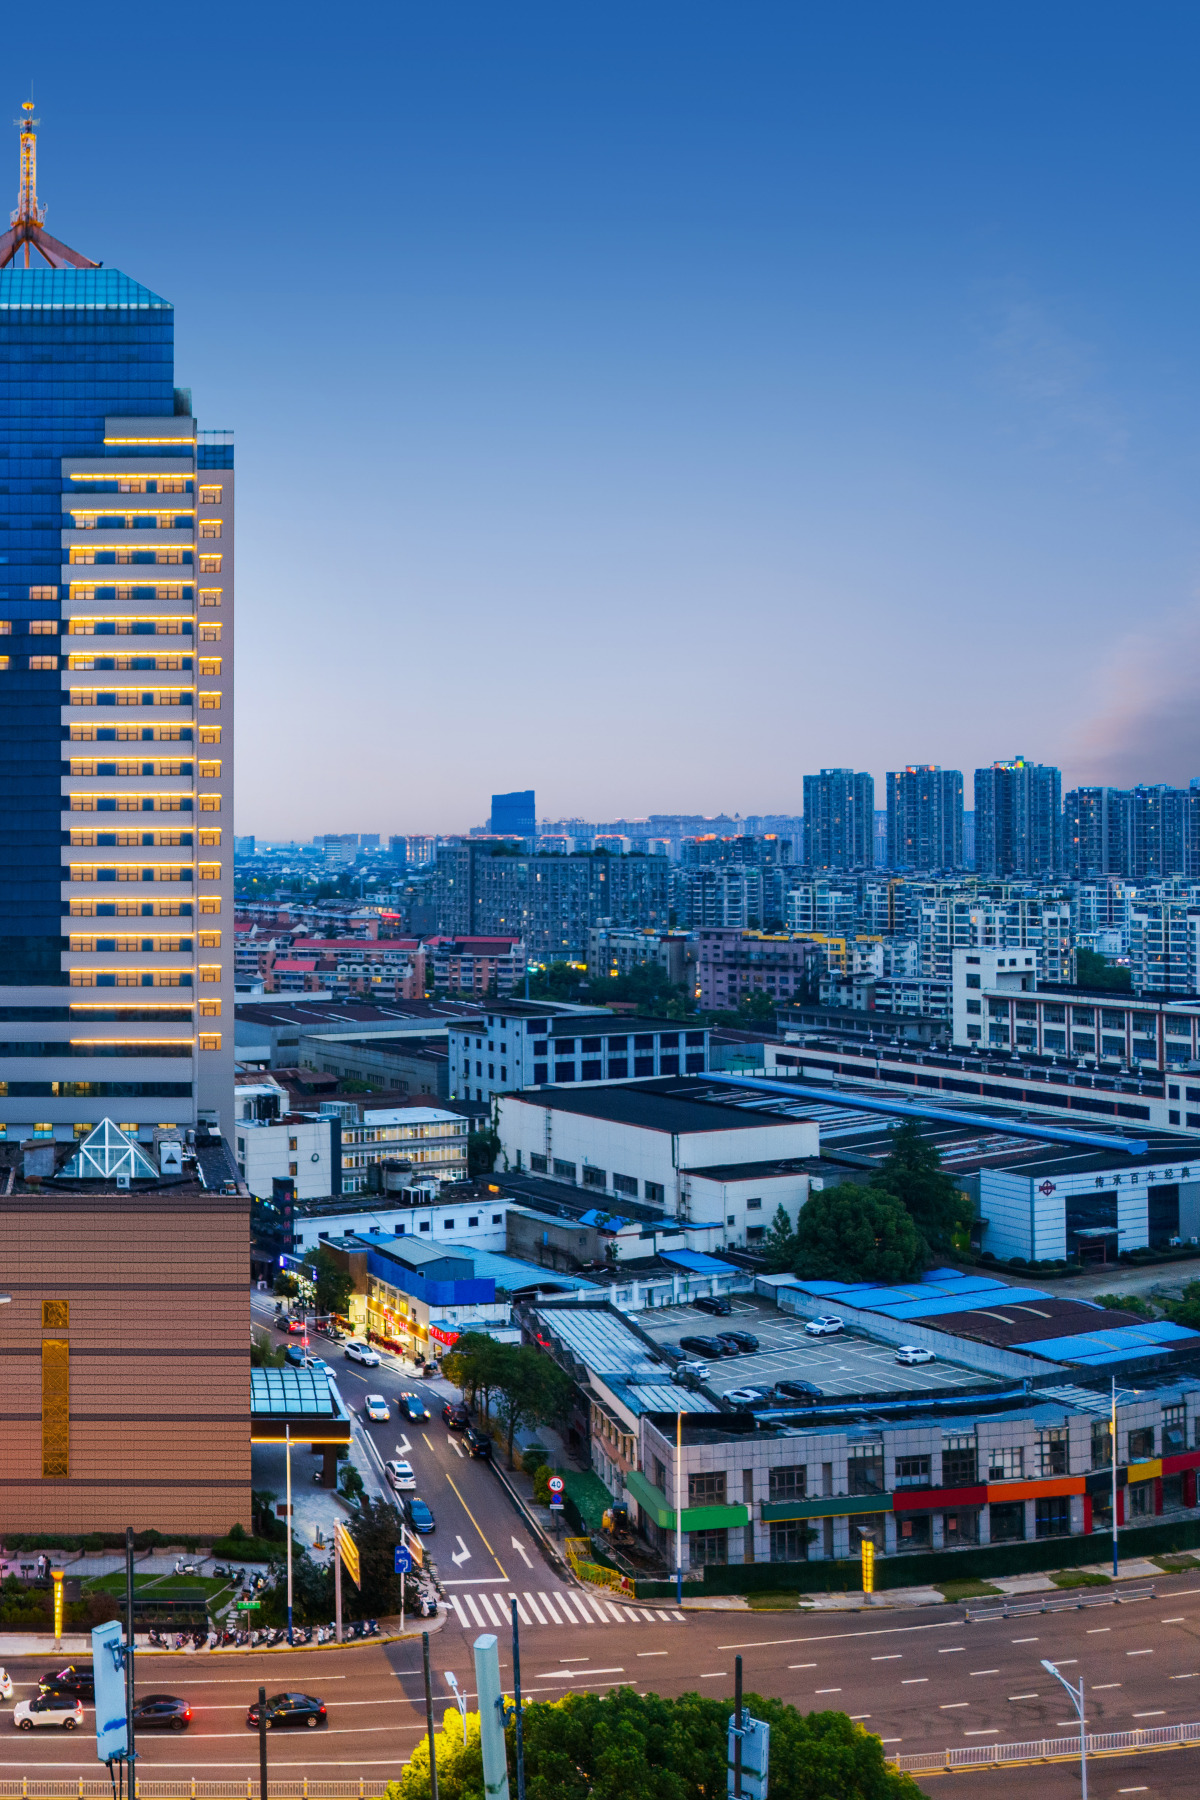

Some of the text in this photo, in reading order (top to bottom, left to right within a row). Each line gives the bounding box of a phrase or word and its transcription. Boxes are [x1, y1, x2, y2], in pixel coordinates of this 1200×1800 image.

[1094, 1166, 1191, 1188] 传承百年经典
[550, 1480, 561, 1489] 40
